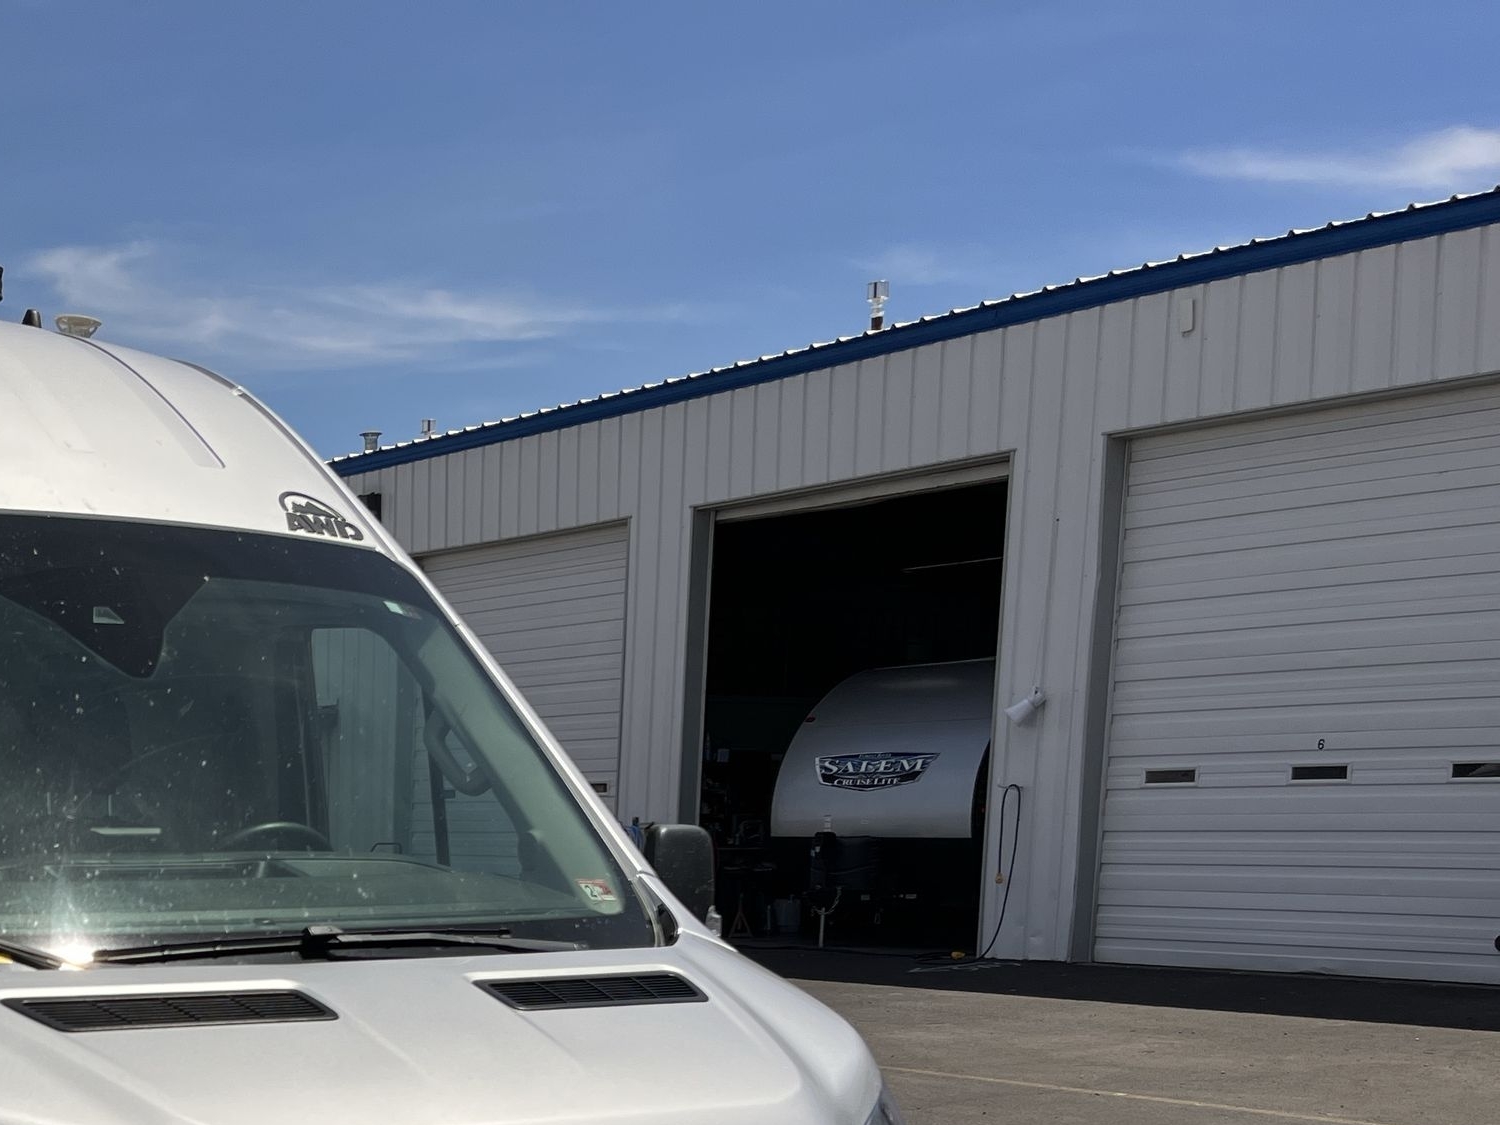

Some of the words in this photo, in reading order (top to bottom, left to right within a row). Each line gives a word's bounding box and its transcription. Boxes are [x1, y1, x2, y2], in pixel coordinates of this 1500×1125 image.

[285, 512, 364, 541] AWD
[1317, 738, 1325, 750] 6
[821, 758, 925, 775] SALEM
